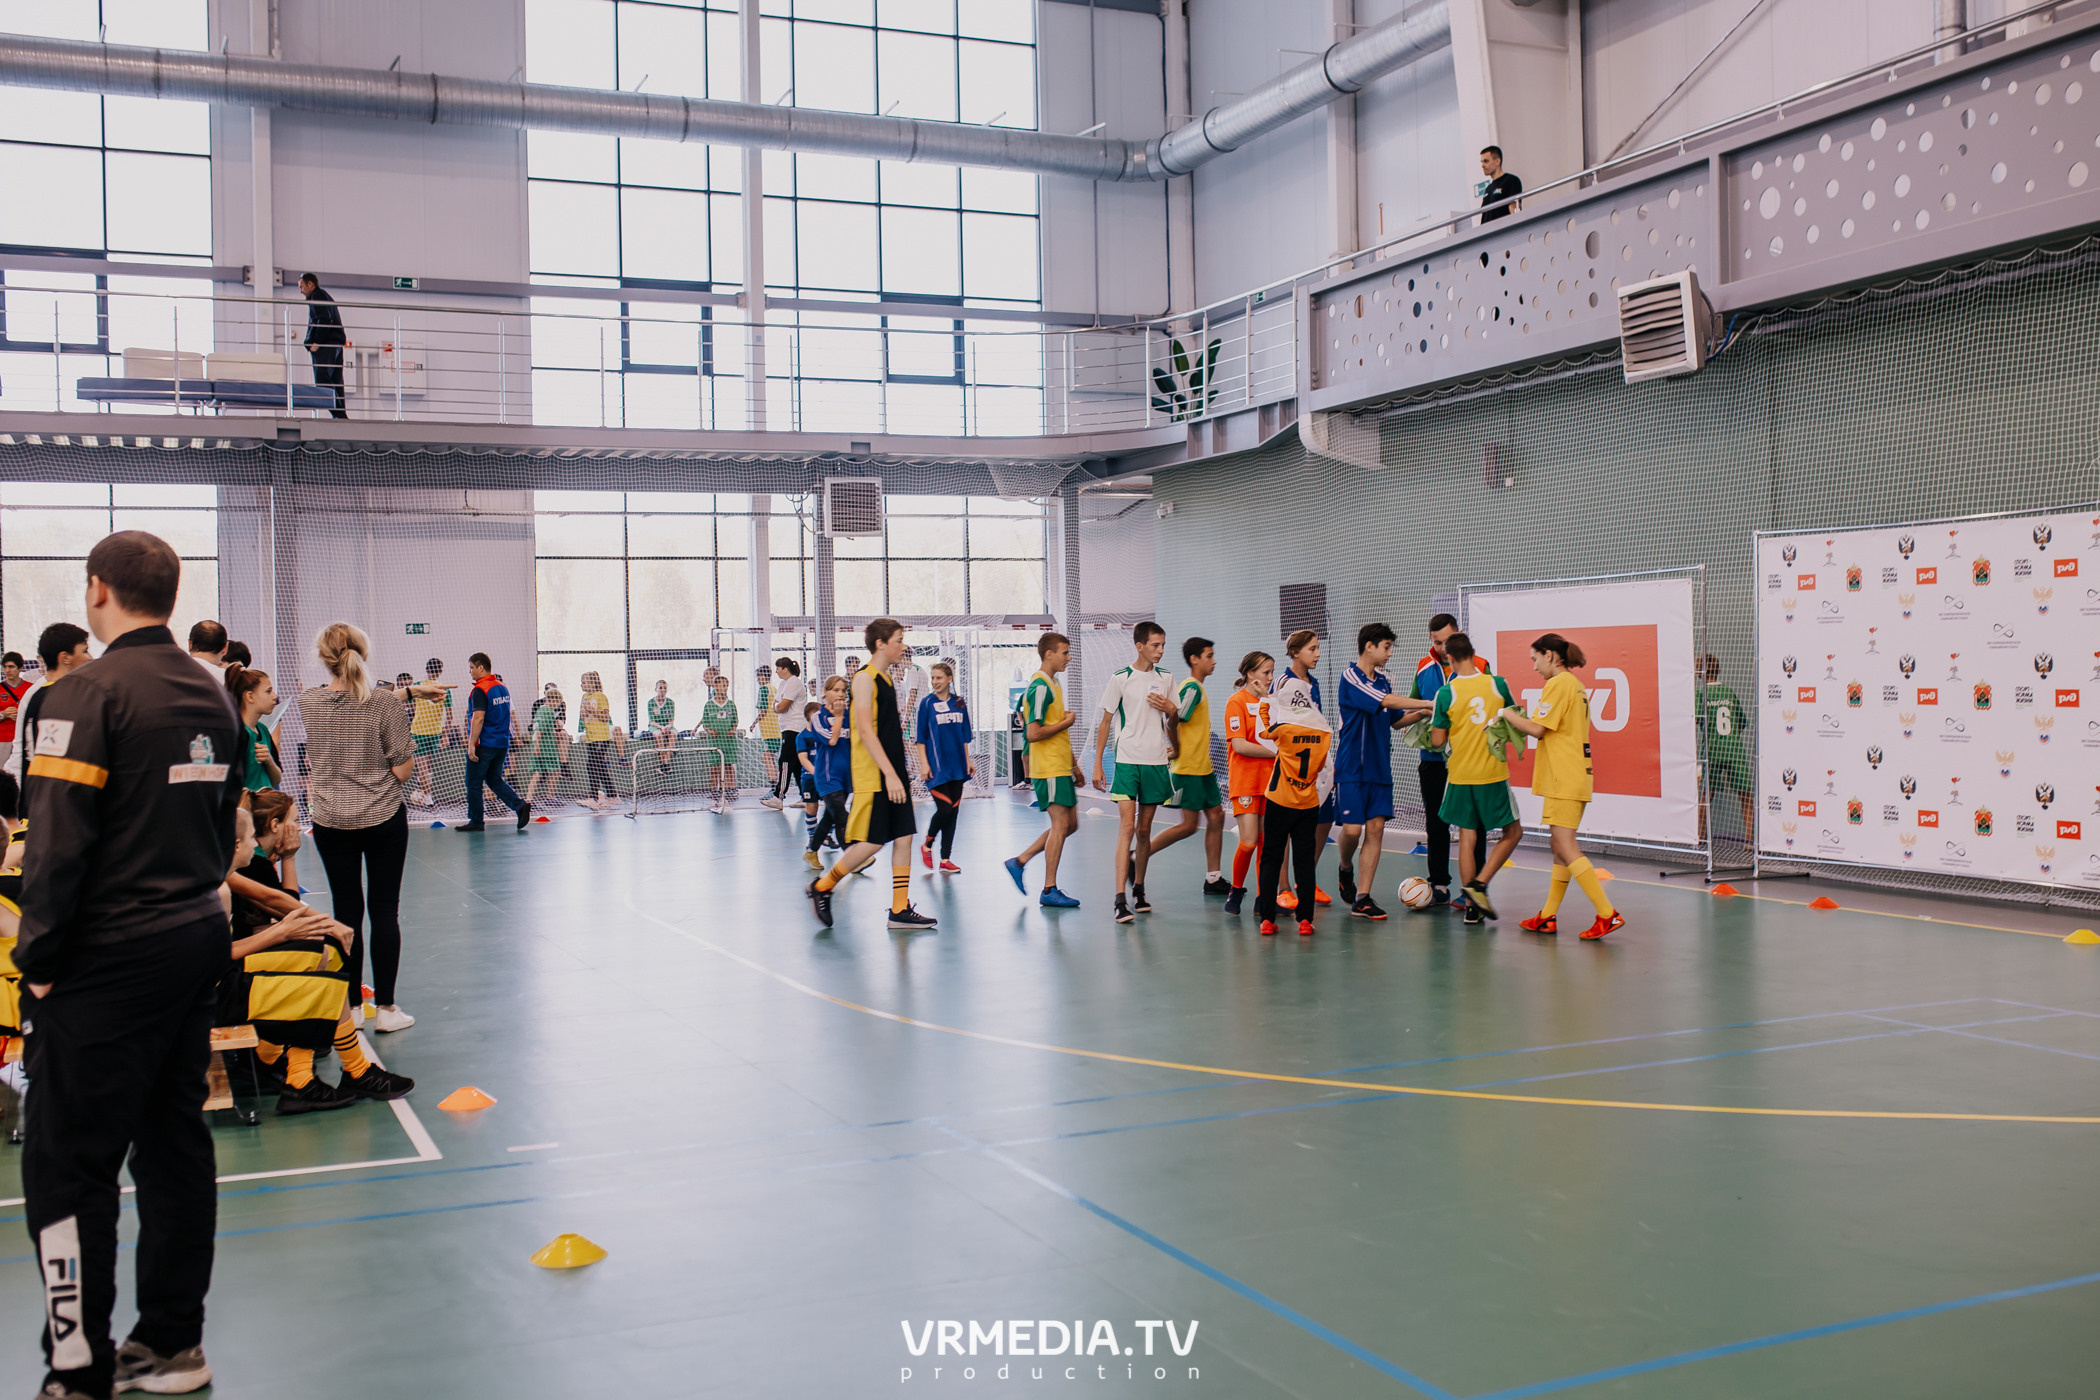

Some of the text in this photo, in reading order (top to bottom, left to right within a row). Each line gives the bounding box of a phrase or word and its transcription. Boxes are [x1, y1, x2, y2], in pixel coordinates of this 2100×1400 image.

[1469, 696, 1487, 725] 3
[1716, 706, 1731, 735] 6
[1292, 735, 1321, 744] ЯГУНОВ
[1295, 748, 1311, 779] 1
[48, 1257, 78, 1341] FILA
